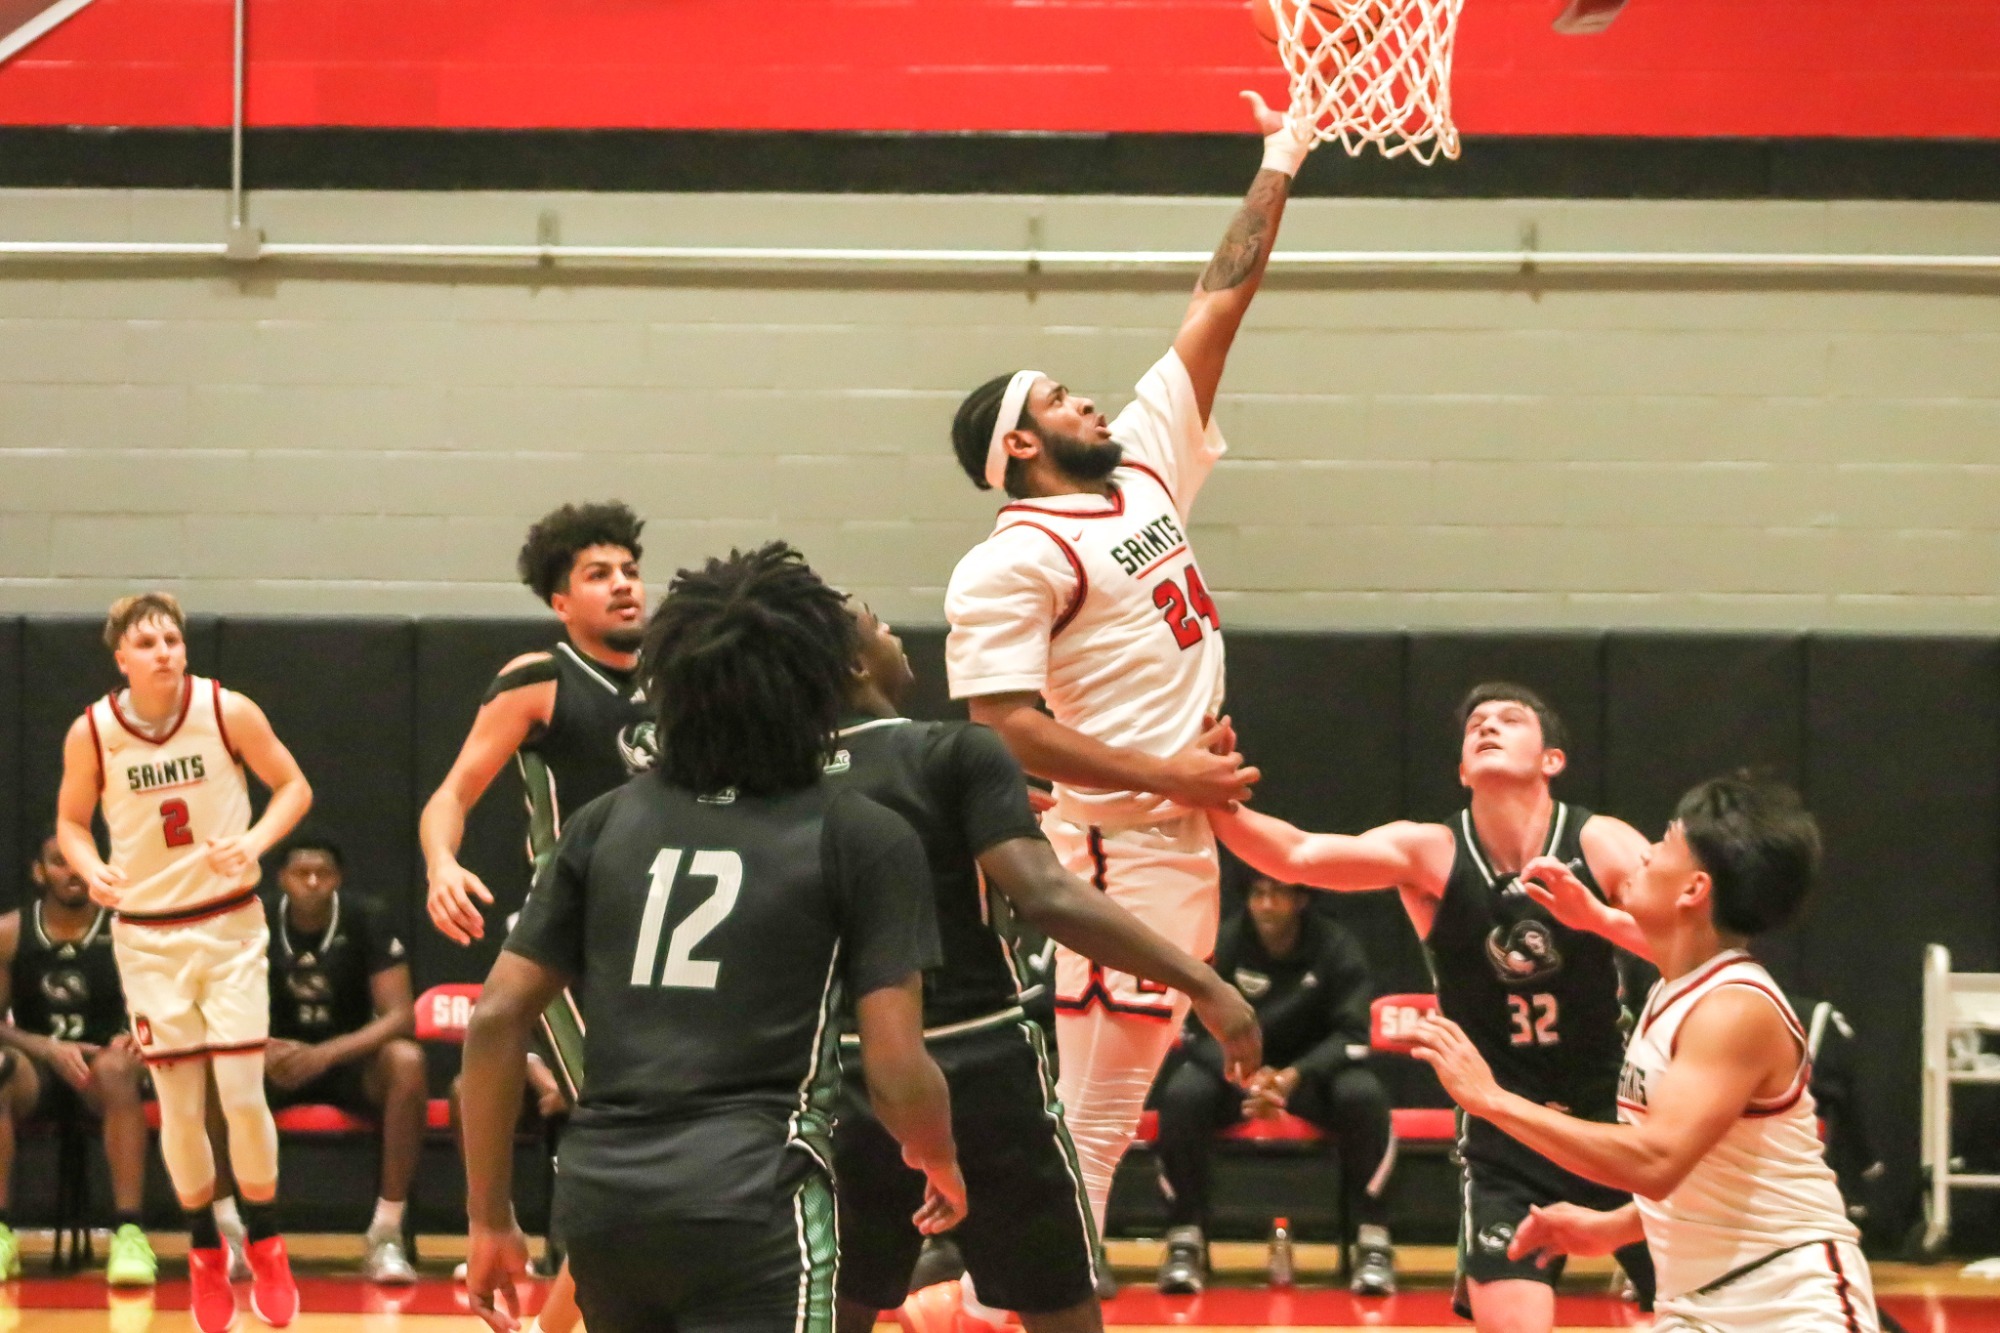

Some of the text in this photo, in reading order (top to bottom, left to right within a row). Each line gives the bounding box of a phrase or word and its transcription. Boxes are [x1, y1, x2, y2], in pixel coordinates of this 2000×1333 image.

[1152, 563, 1220, 651] 24
[160, 797, 194, 848] 2
[630, 848, 743, 989] 12
[1381, 1005, 1422, 1036] SA
[1507, 993, 1560, 1047] 32
